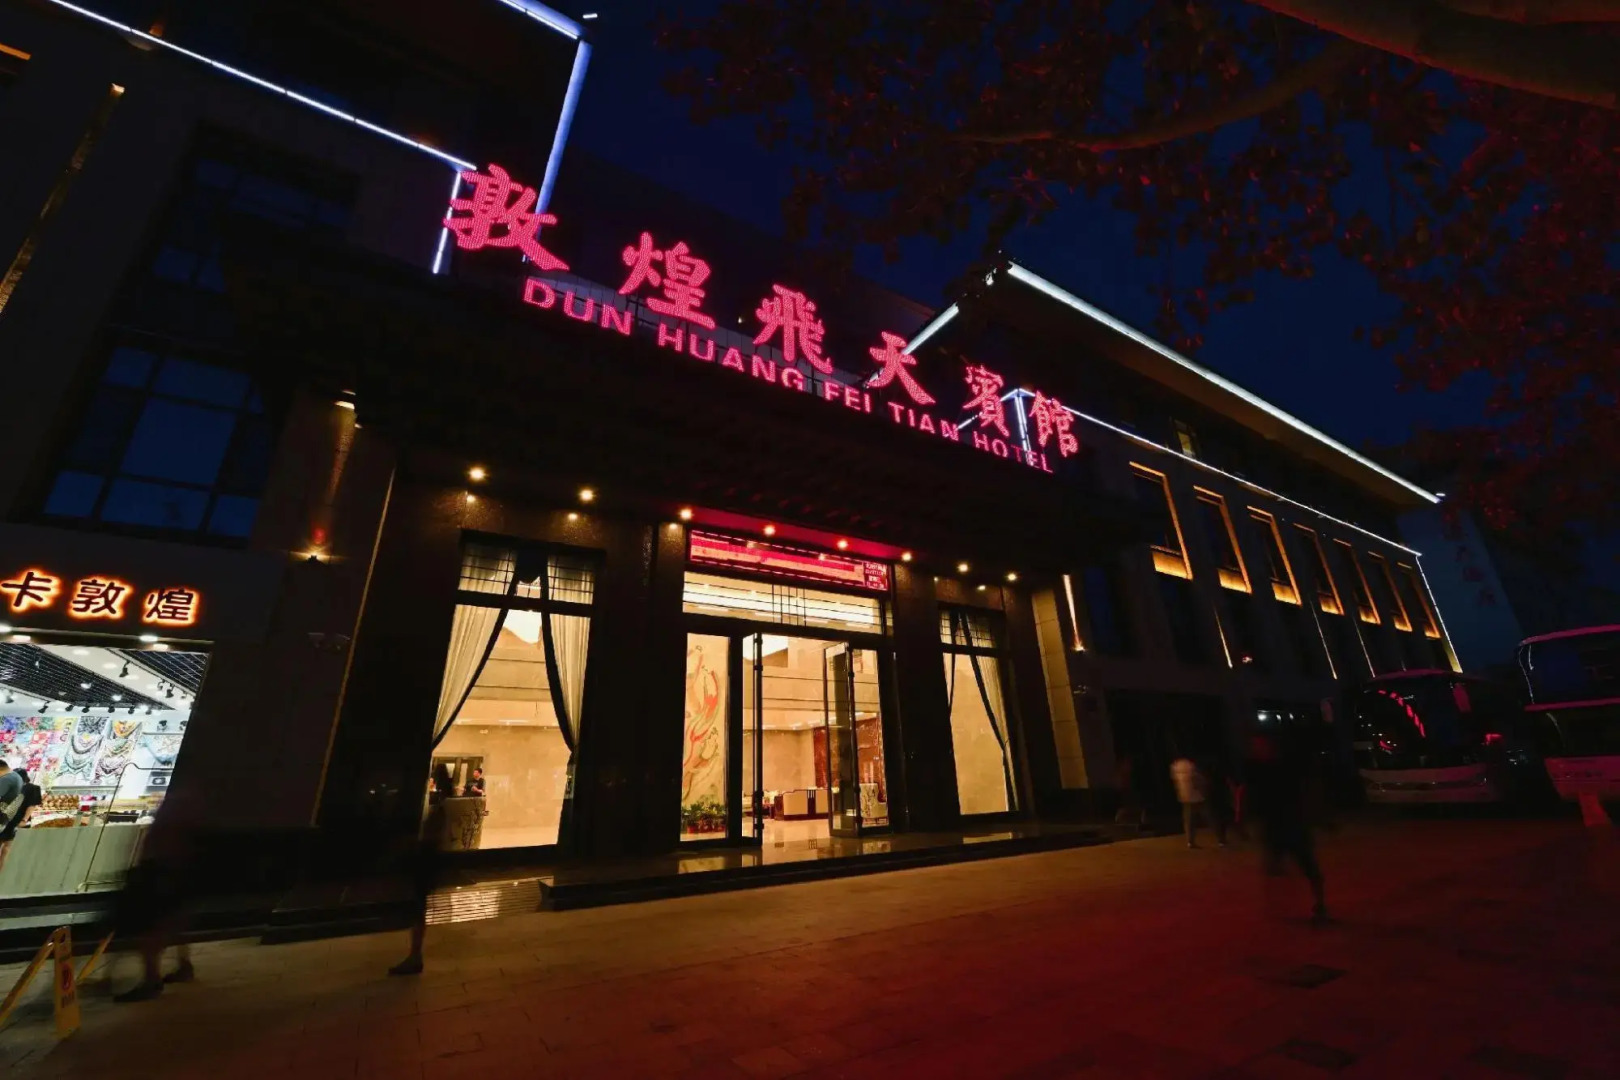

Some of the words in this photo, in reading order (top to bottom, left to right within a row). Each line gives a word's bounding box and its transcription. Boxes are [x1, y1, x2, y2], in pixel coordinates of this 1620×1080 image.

[522, 276, 632, 336] DUN
[658, 322, 803, 391] HUANG
[823, 378, 873, 415] FEI
[888, 401, 960, 441] TIAN
[973, 430, 1053, 473] HOTEL
[1, 571, 194, 622] 卡敦煌
